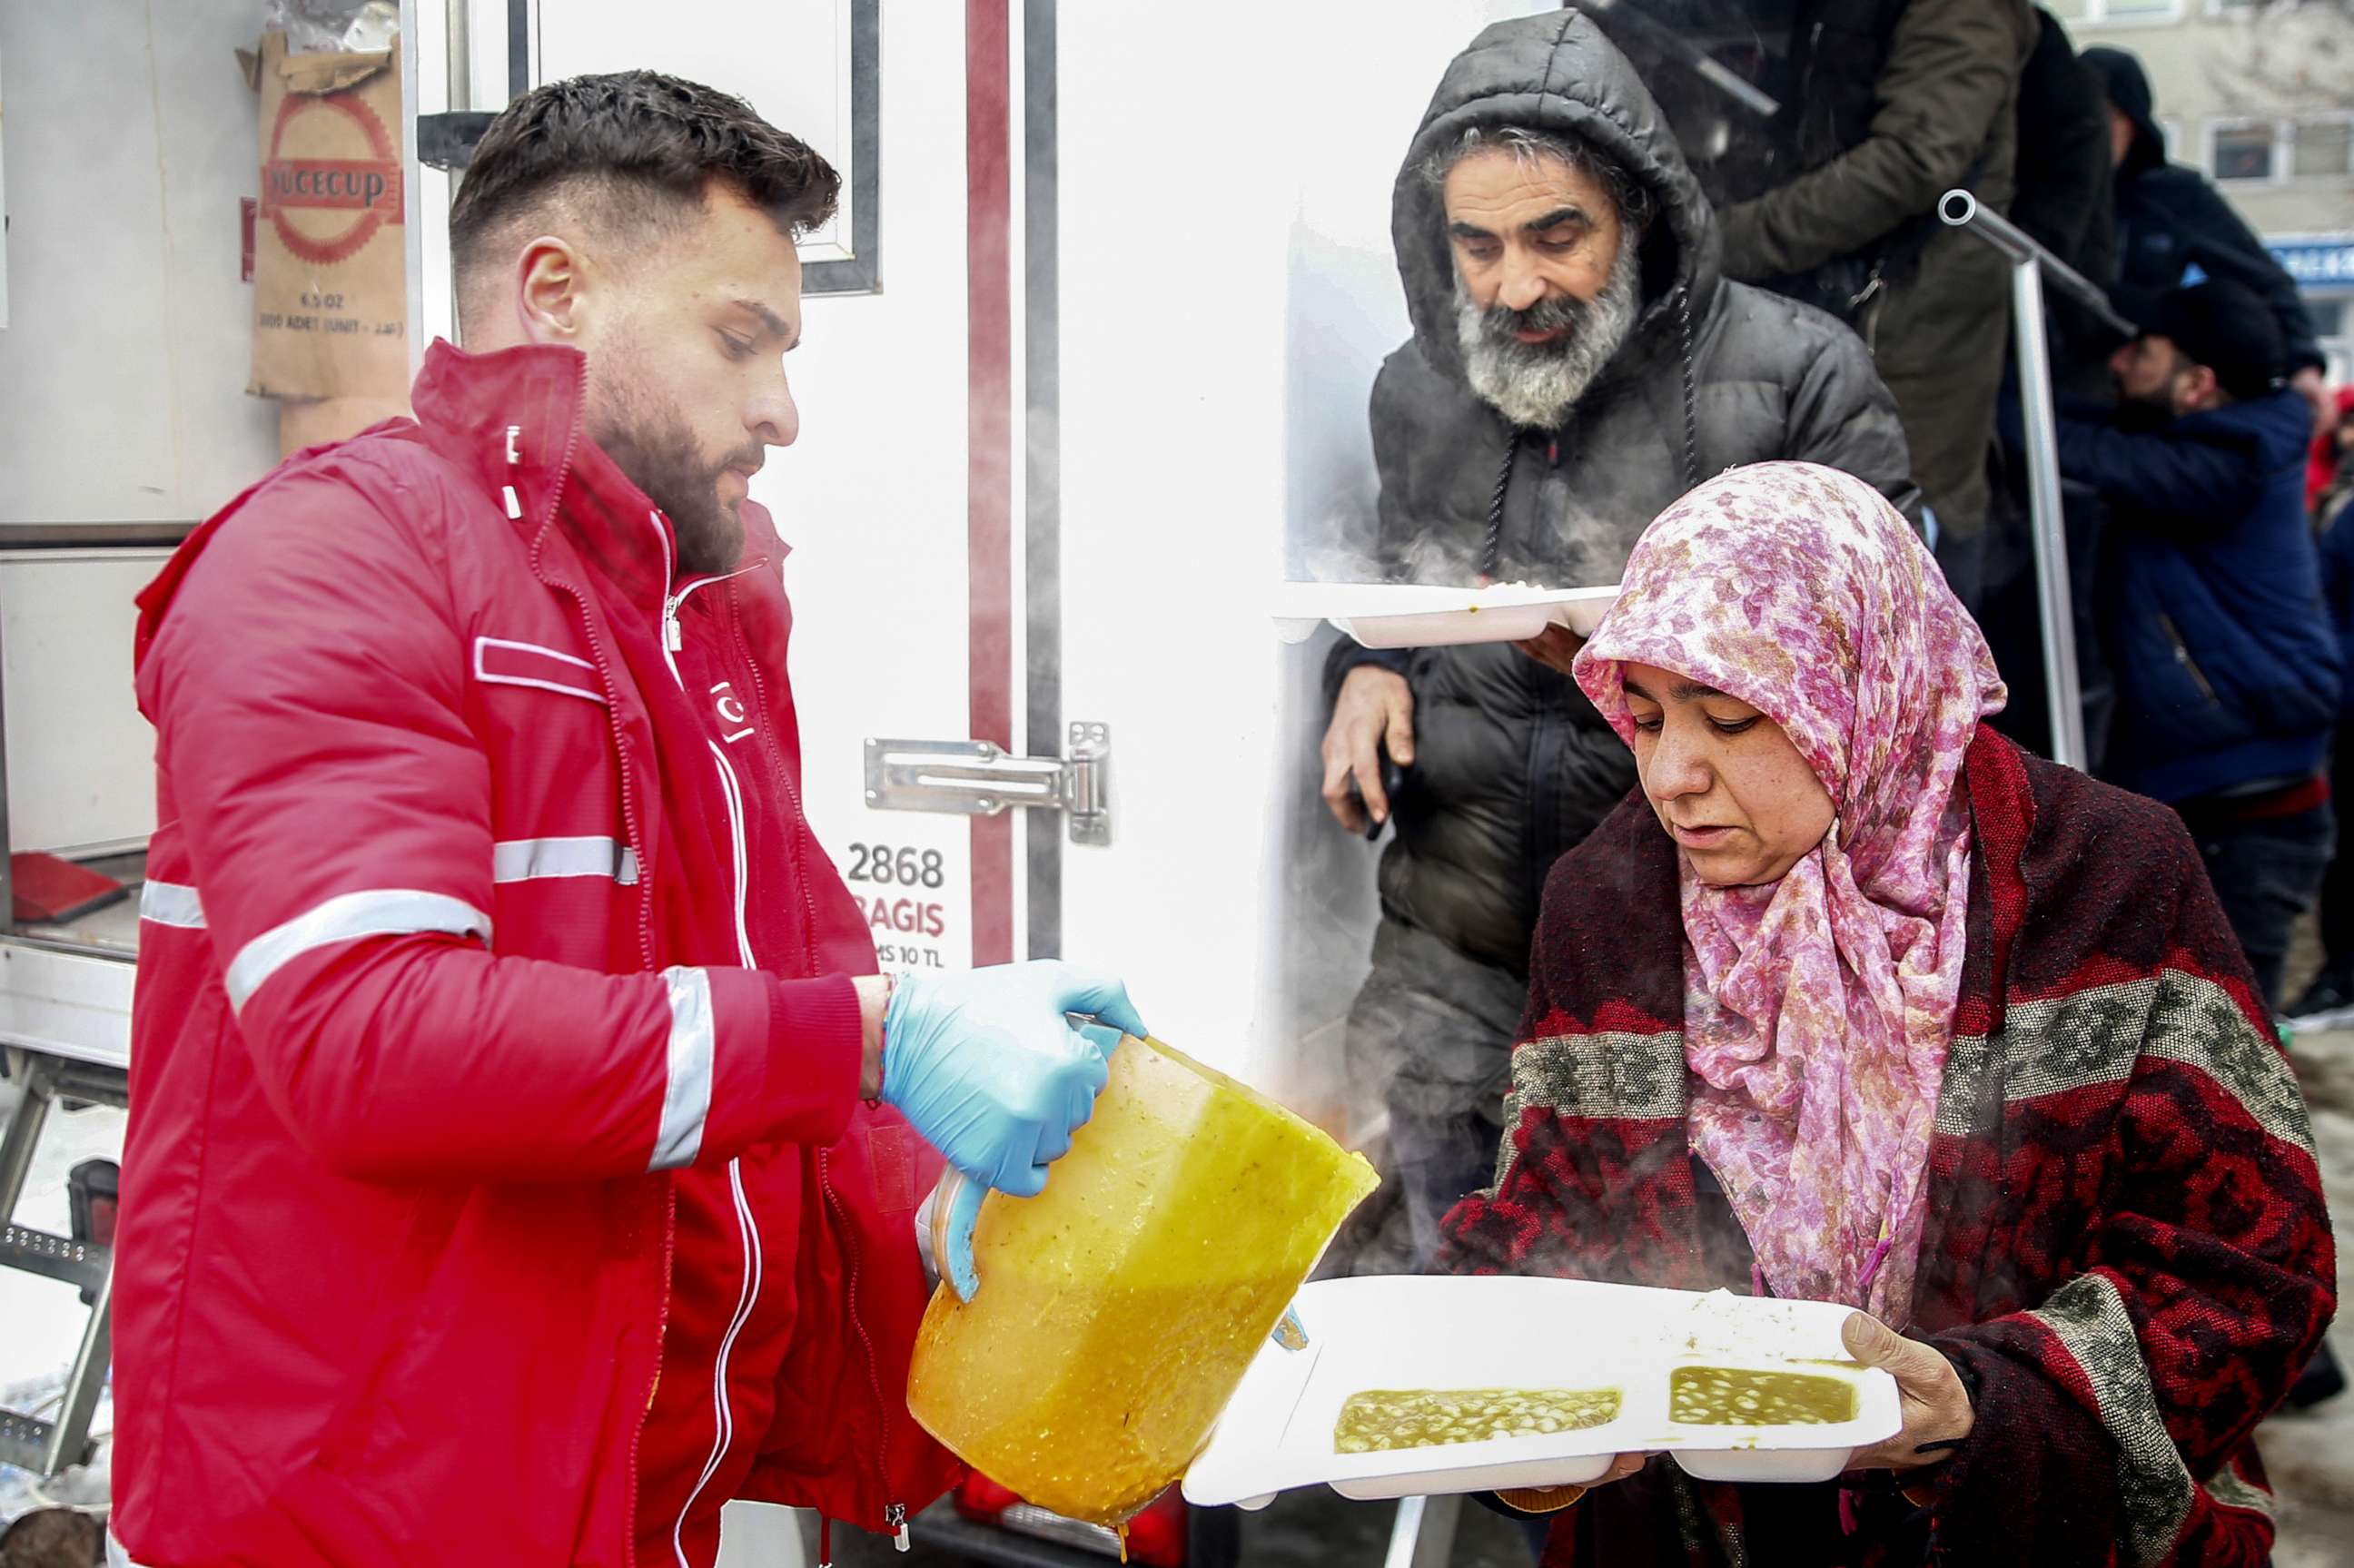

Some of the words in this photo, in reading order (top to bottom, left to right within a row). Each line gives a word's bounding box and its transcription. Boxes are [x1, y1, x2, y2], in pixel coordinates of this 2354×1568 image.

[848, 843, 945, 888] 2868
[899, 945, 919, 965] 10
[923, 948, 945, 969] TL
